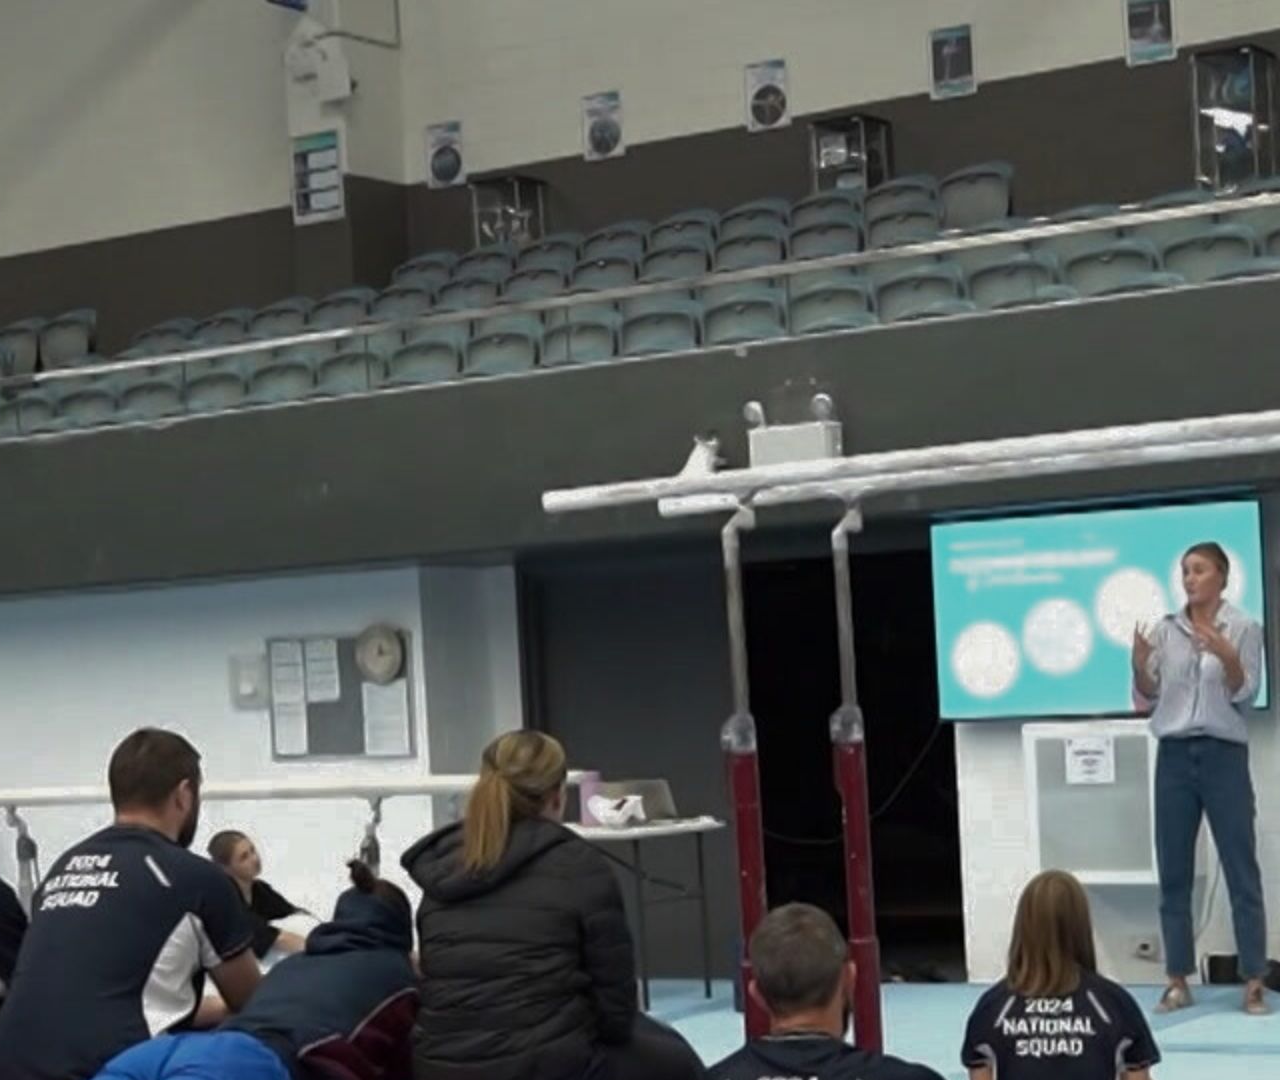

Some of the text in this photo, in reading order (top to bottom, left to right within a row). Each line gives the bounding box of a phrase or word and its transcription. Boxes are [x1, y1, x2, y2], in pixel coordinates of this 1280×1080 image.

[1024, 997, 1075, 1014] 2024
[1002, 1016, 1096, 1036] NATIONAL
[1015, 1038, 1084, 1058] SQUAD
